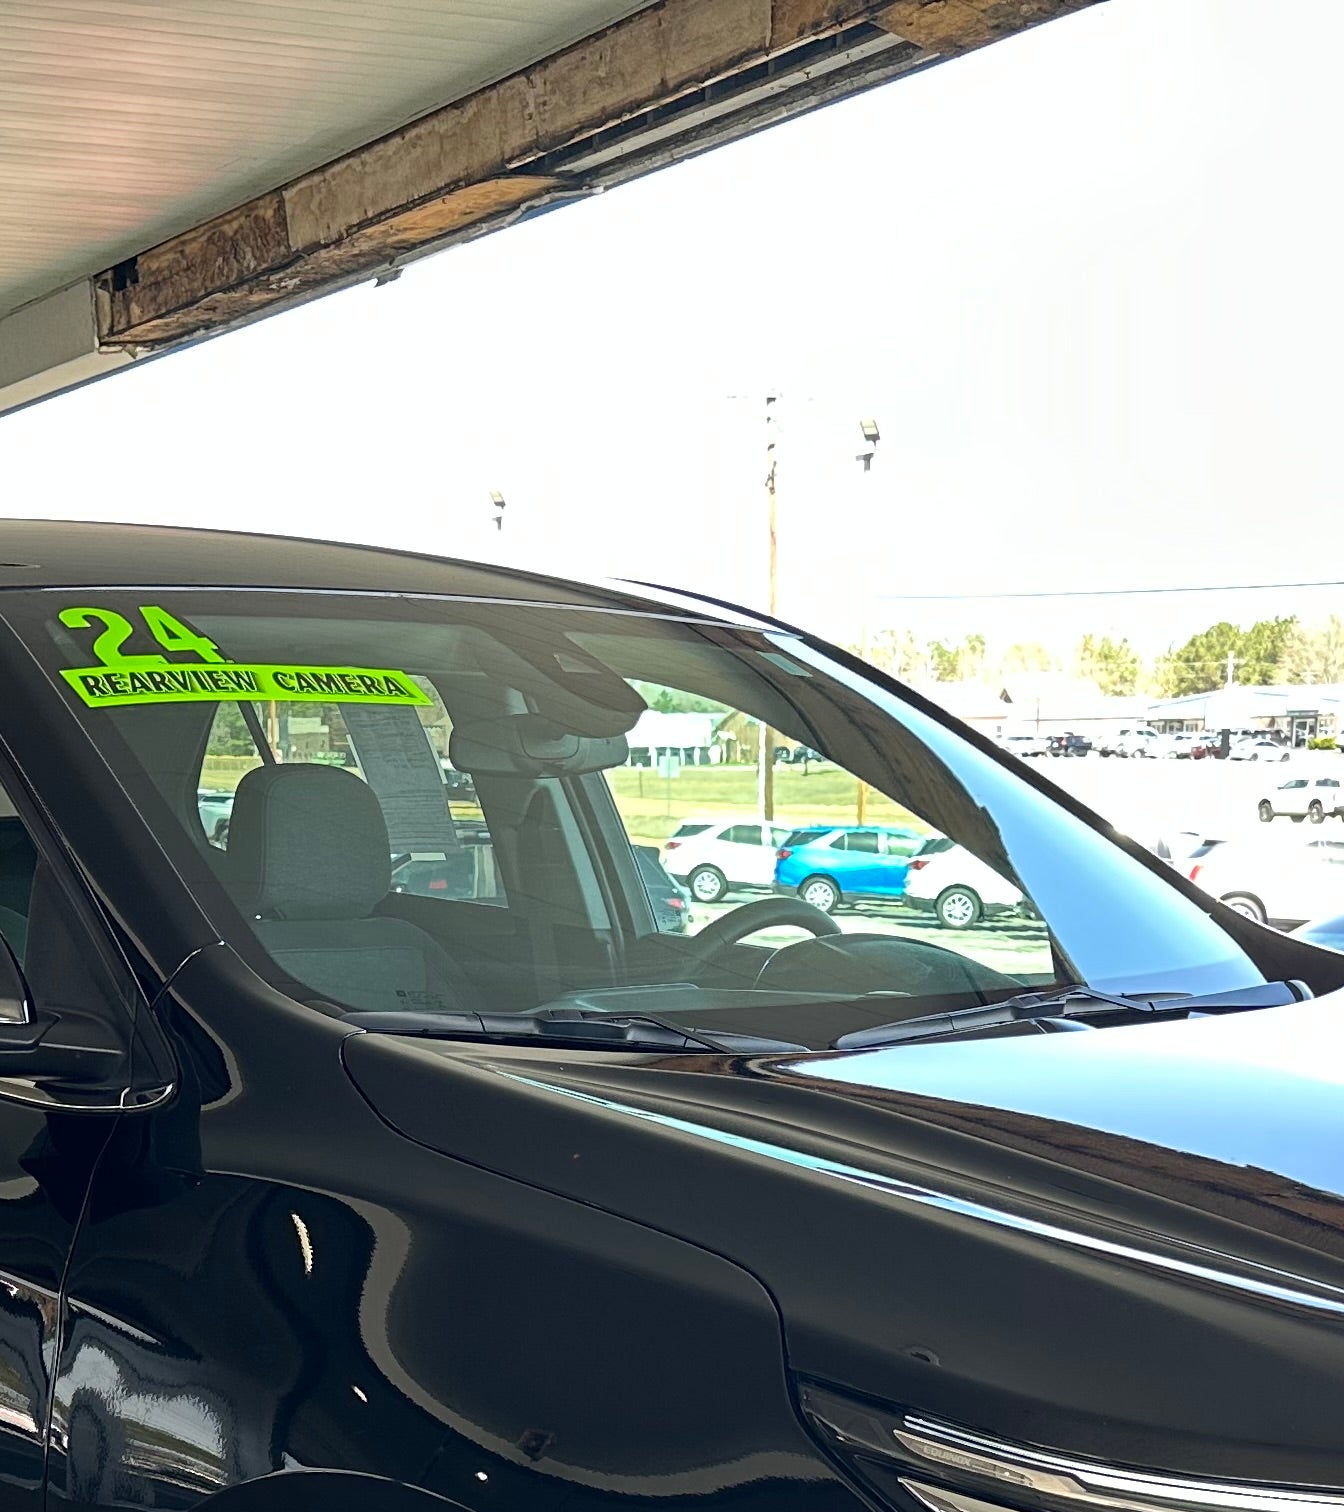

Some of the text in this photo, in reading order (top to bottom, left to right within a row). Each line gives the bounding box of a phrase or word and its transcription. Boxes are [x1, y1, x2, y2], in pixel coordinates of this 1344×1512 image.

[58, 605, 225, 667] 24
[77, 669, 408, 698] REARVIEW CAMERA
[922, 1445, 972, 1467] EQUINOX
